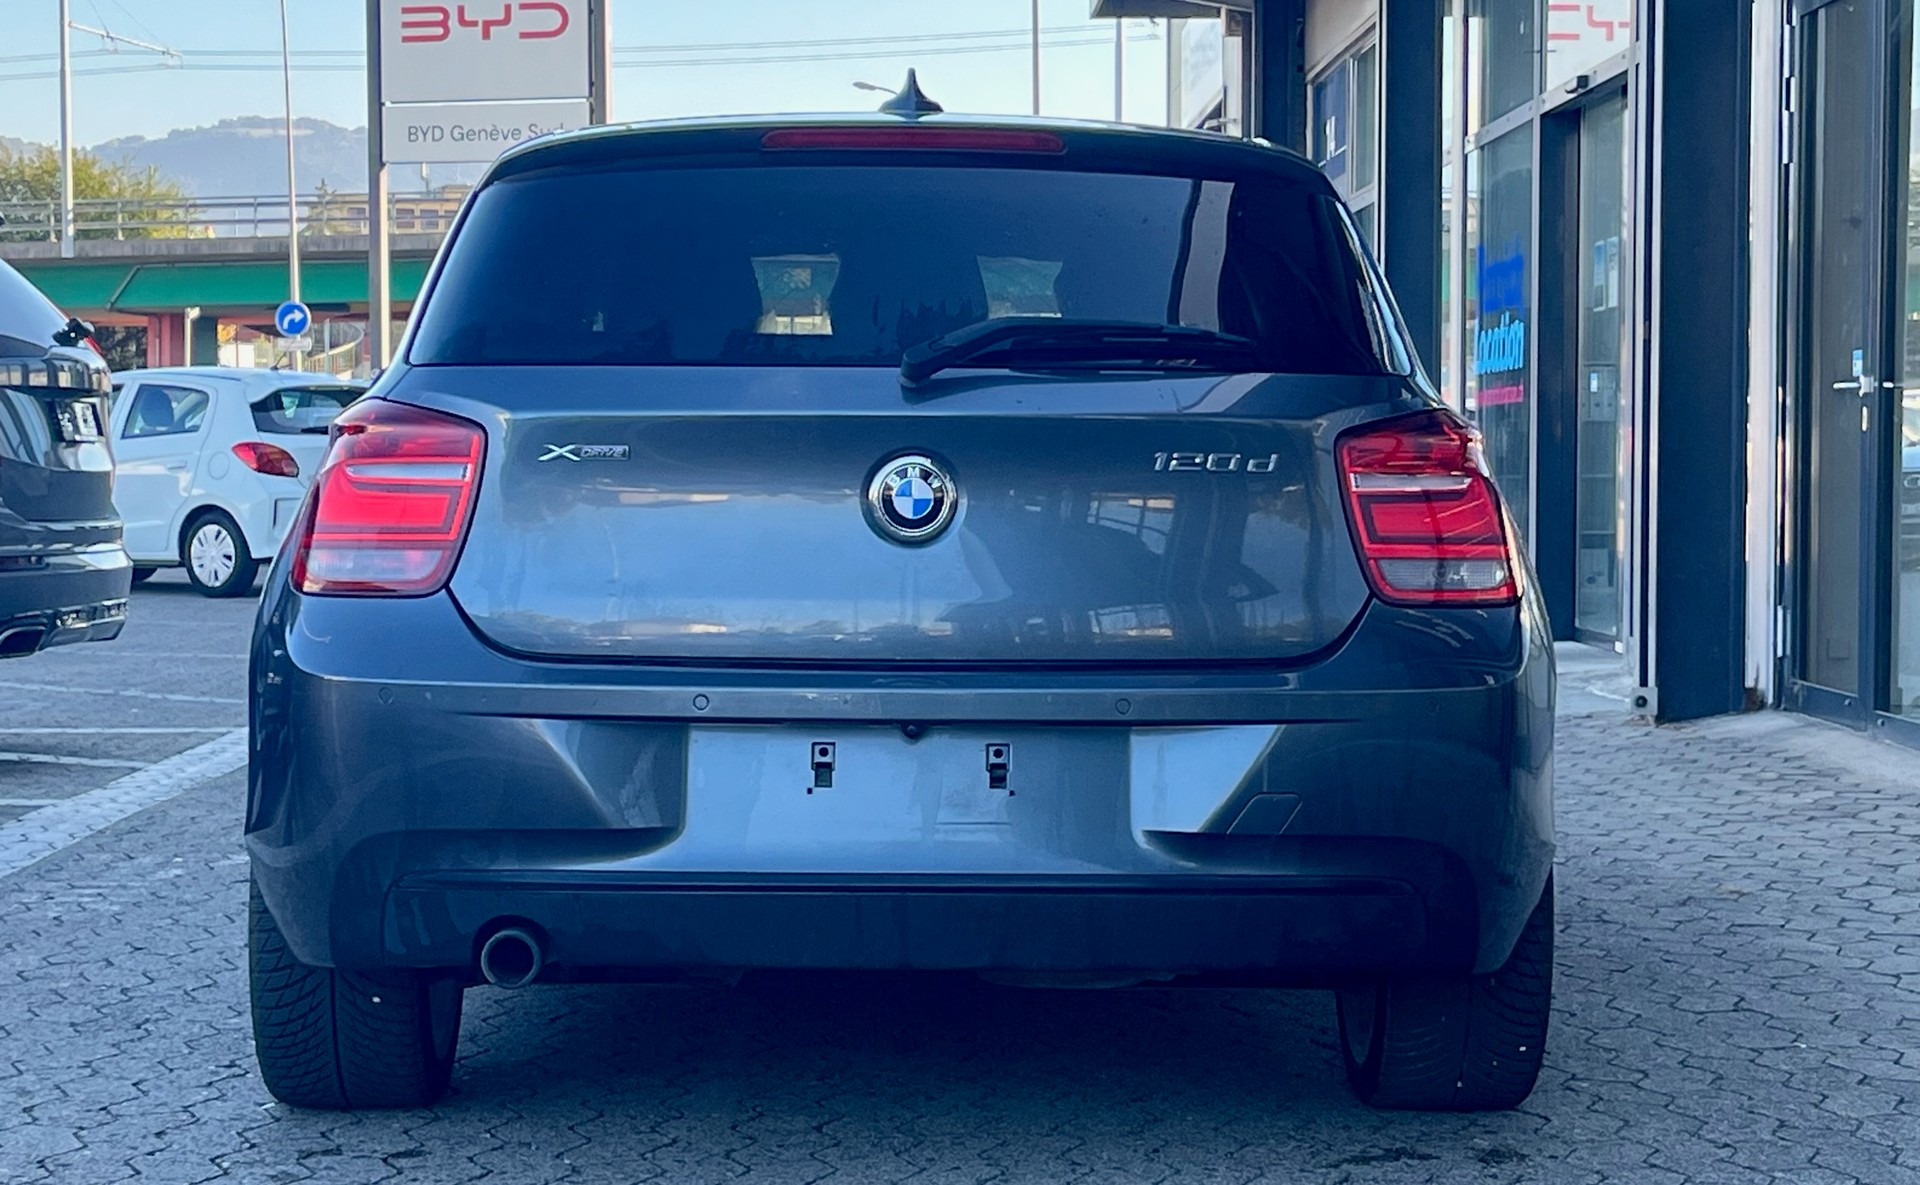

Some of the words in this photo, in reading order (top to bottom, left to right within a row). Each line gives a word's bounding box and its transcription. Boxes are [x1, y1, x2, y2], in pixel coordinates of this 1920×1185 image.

[401, 2, 569, 43] BYD
[407, 126, 445, 143] BYD
[450, 124, 522, 142] Genève
[887, 466, 943, 489] BMW
